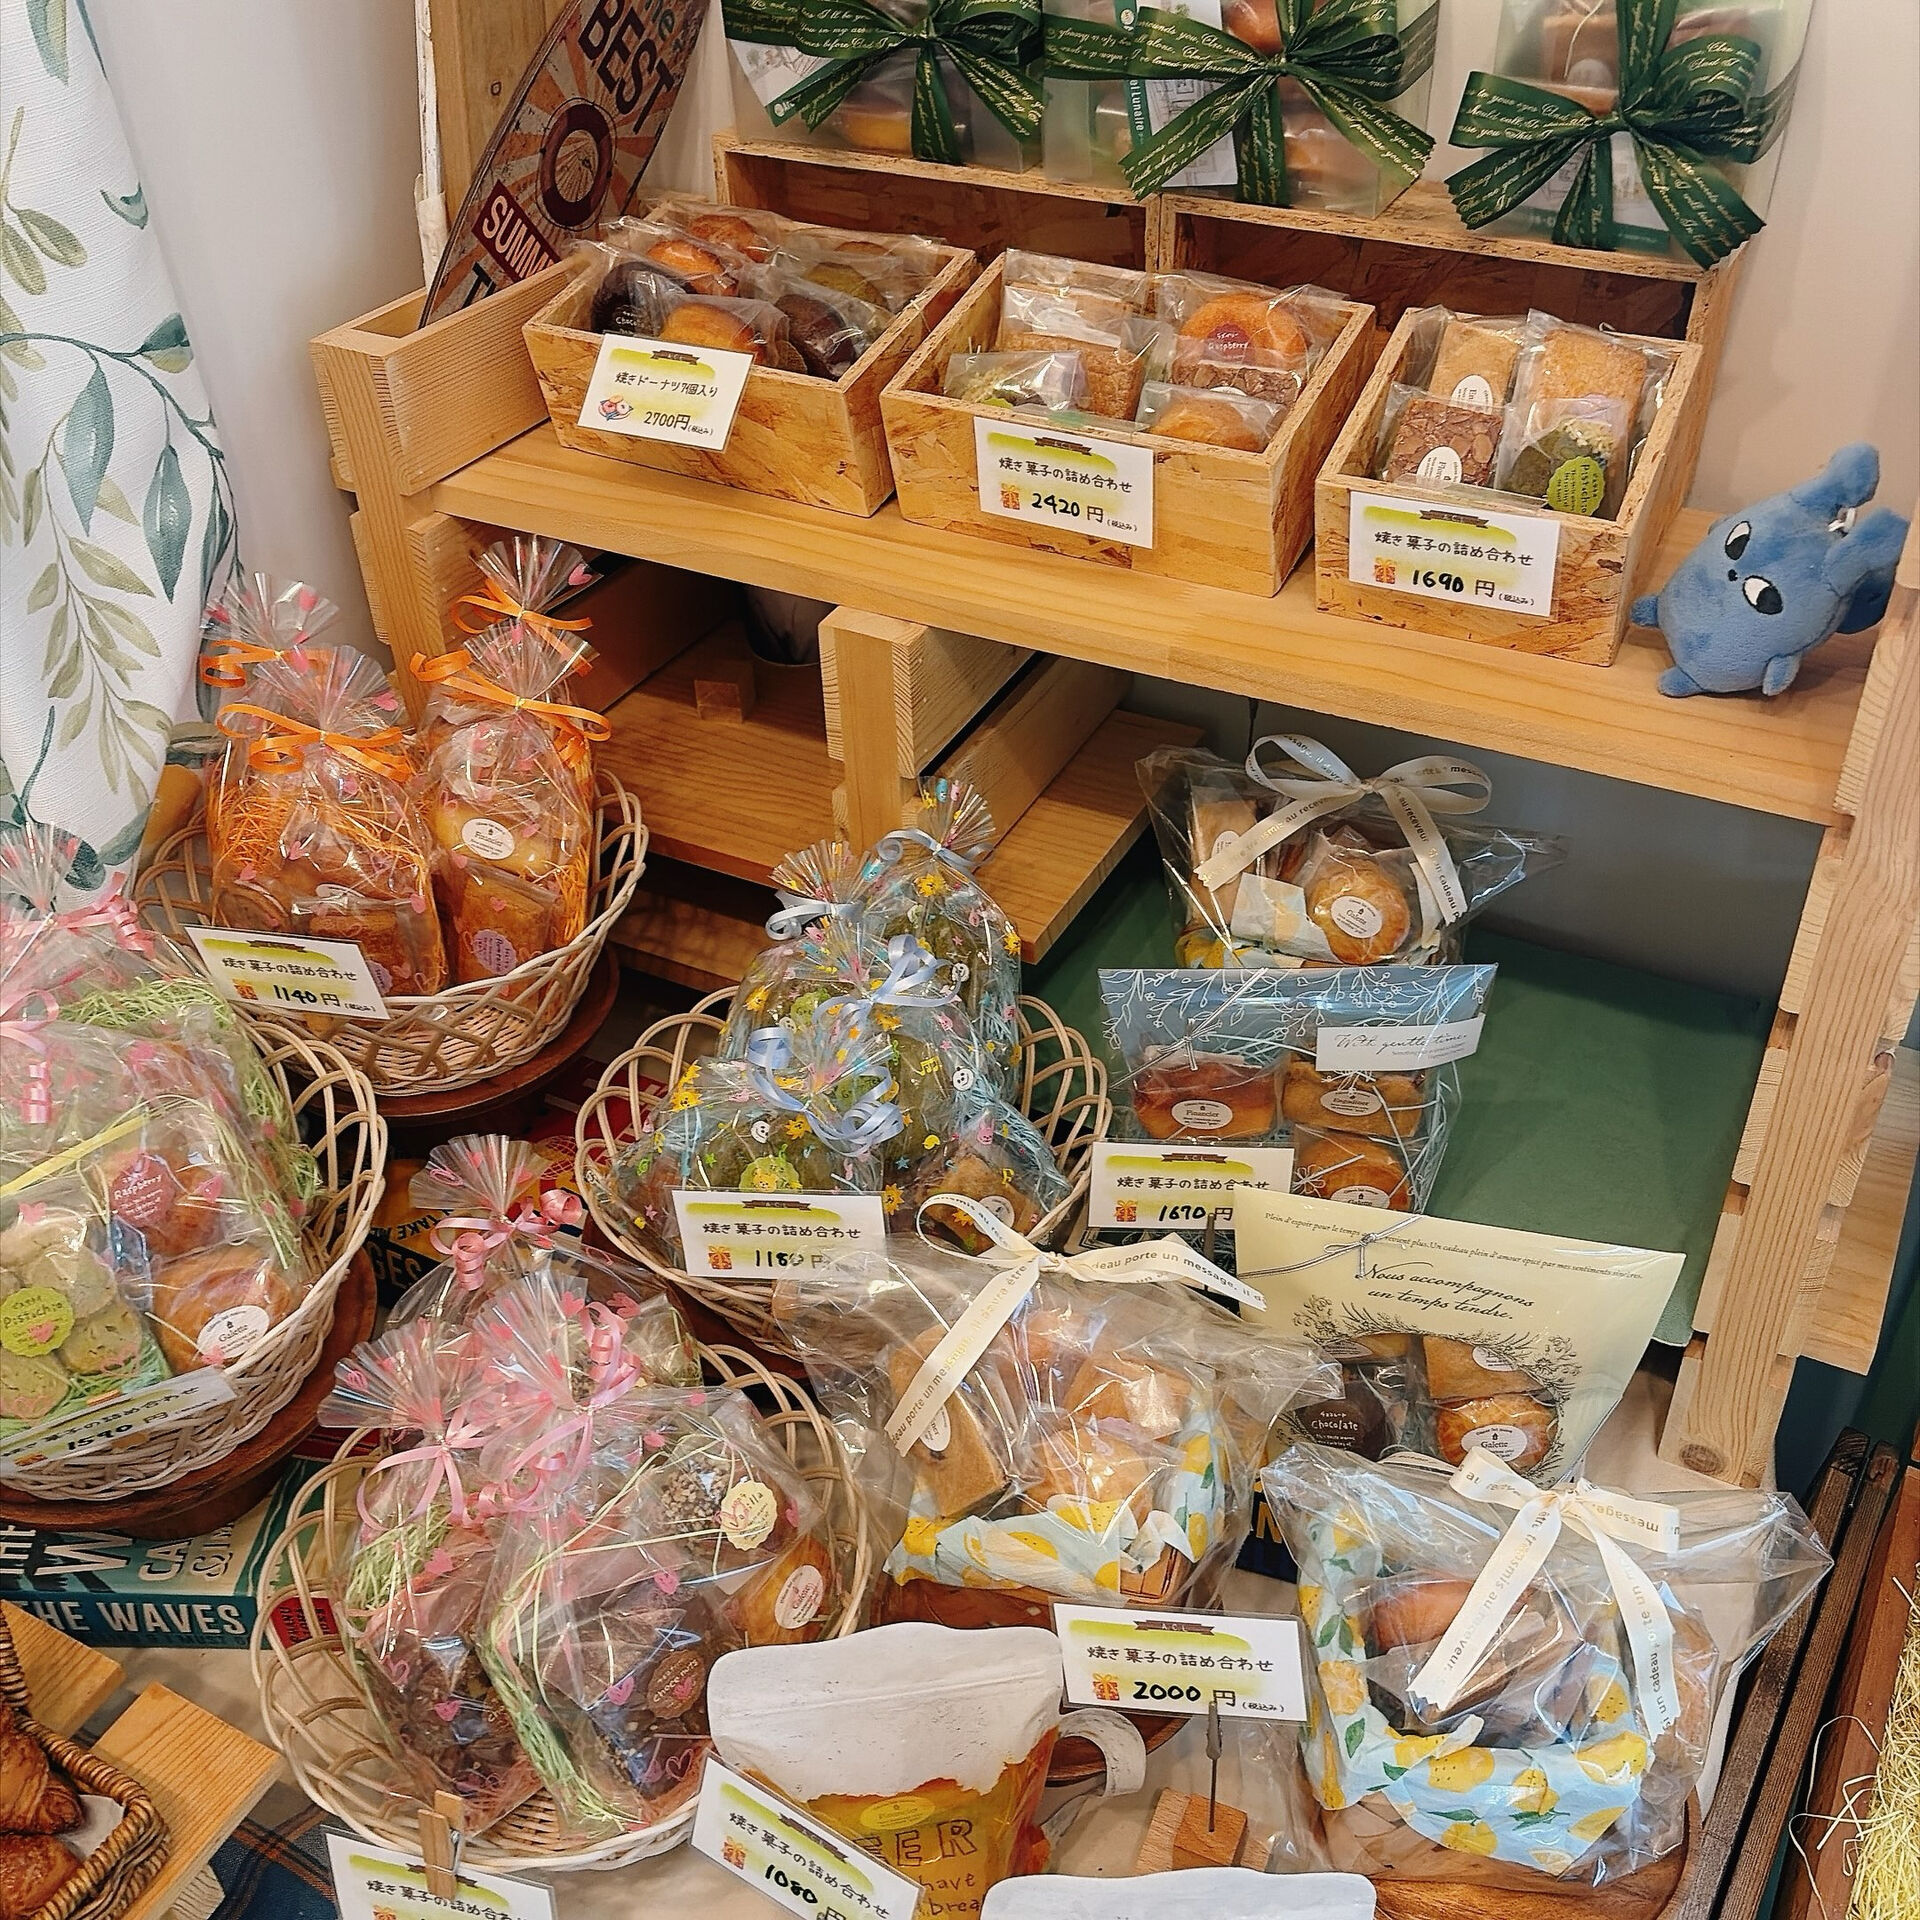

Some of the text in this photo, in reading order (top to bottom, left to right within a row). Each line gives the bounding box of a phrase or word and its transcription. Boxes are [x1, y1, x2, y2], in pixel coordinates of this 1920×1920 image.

[615, 372, 718, 397] 焼きドーナツ7個入り
[998, 457, 1132, 493] 焼き菓子の詰め合わせ
[1032, 492, 1080, 517] 2420
[1087, 506, 1104, 523] 円
[1374, 531, 1534, 566] 焼き菓子の詰め合わせ
[1412, 570, 1464, 593] 1690
[1475, 579, 1495, 598] 円
[222, 957, 357, 981] 焼き菓子の詰め合わせ
[273, 985, 317, 1004] 1140
[320, 992, 340, 1007] 円
[114, 1175, 162, 1200] Raspberry
[1158, 1205, 1233, 1221] 1670 円
[702, 1223, 861, 1239] 焼き菓子の詰め合わせ
[1124, 1252, 1158, 1265] porte
[1162, 1253, 1179, 1262] un
[1368, 1290, 1393, 1299] un
[1410, 1275, 1534, 1307] accompagnons
[3, 1302, 63, 1328] Pistachio
[906, 1399, 925, 1425] porte
[1311, 1420, 1358, 1431] Chocolate
[96, 1602, 247, 1635] WAVES
[1087, 1646, 1274, 1672] 焼き菓子の詰め合わせ
[1649, 1652, 1661, 1693] cadeau
[1132, 1681, 1201, 1702] 2000
[1213, 1689, 1236, 1707] 円
[729, 1812, 890, 1919] 焼き菓子の詰め合わせ
[765, 1864, 818, 1904] 1080
